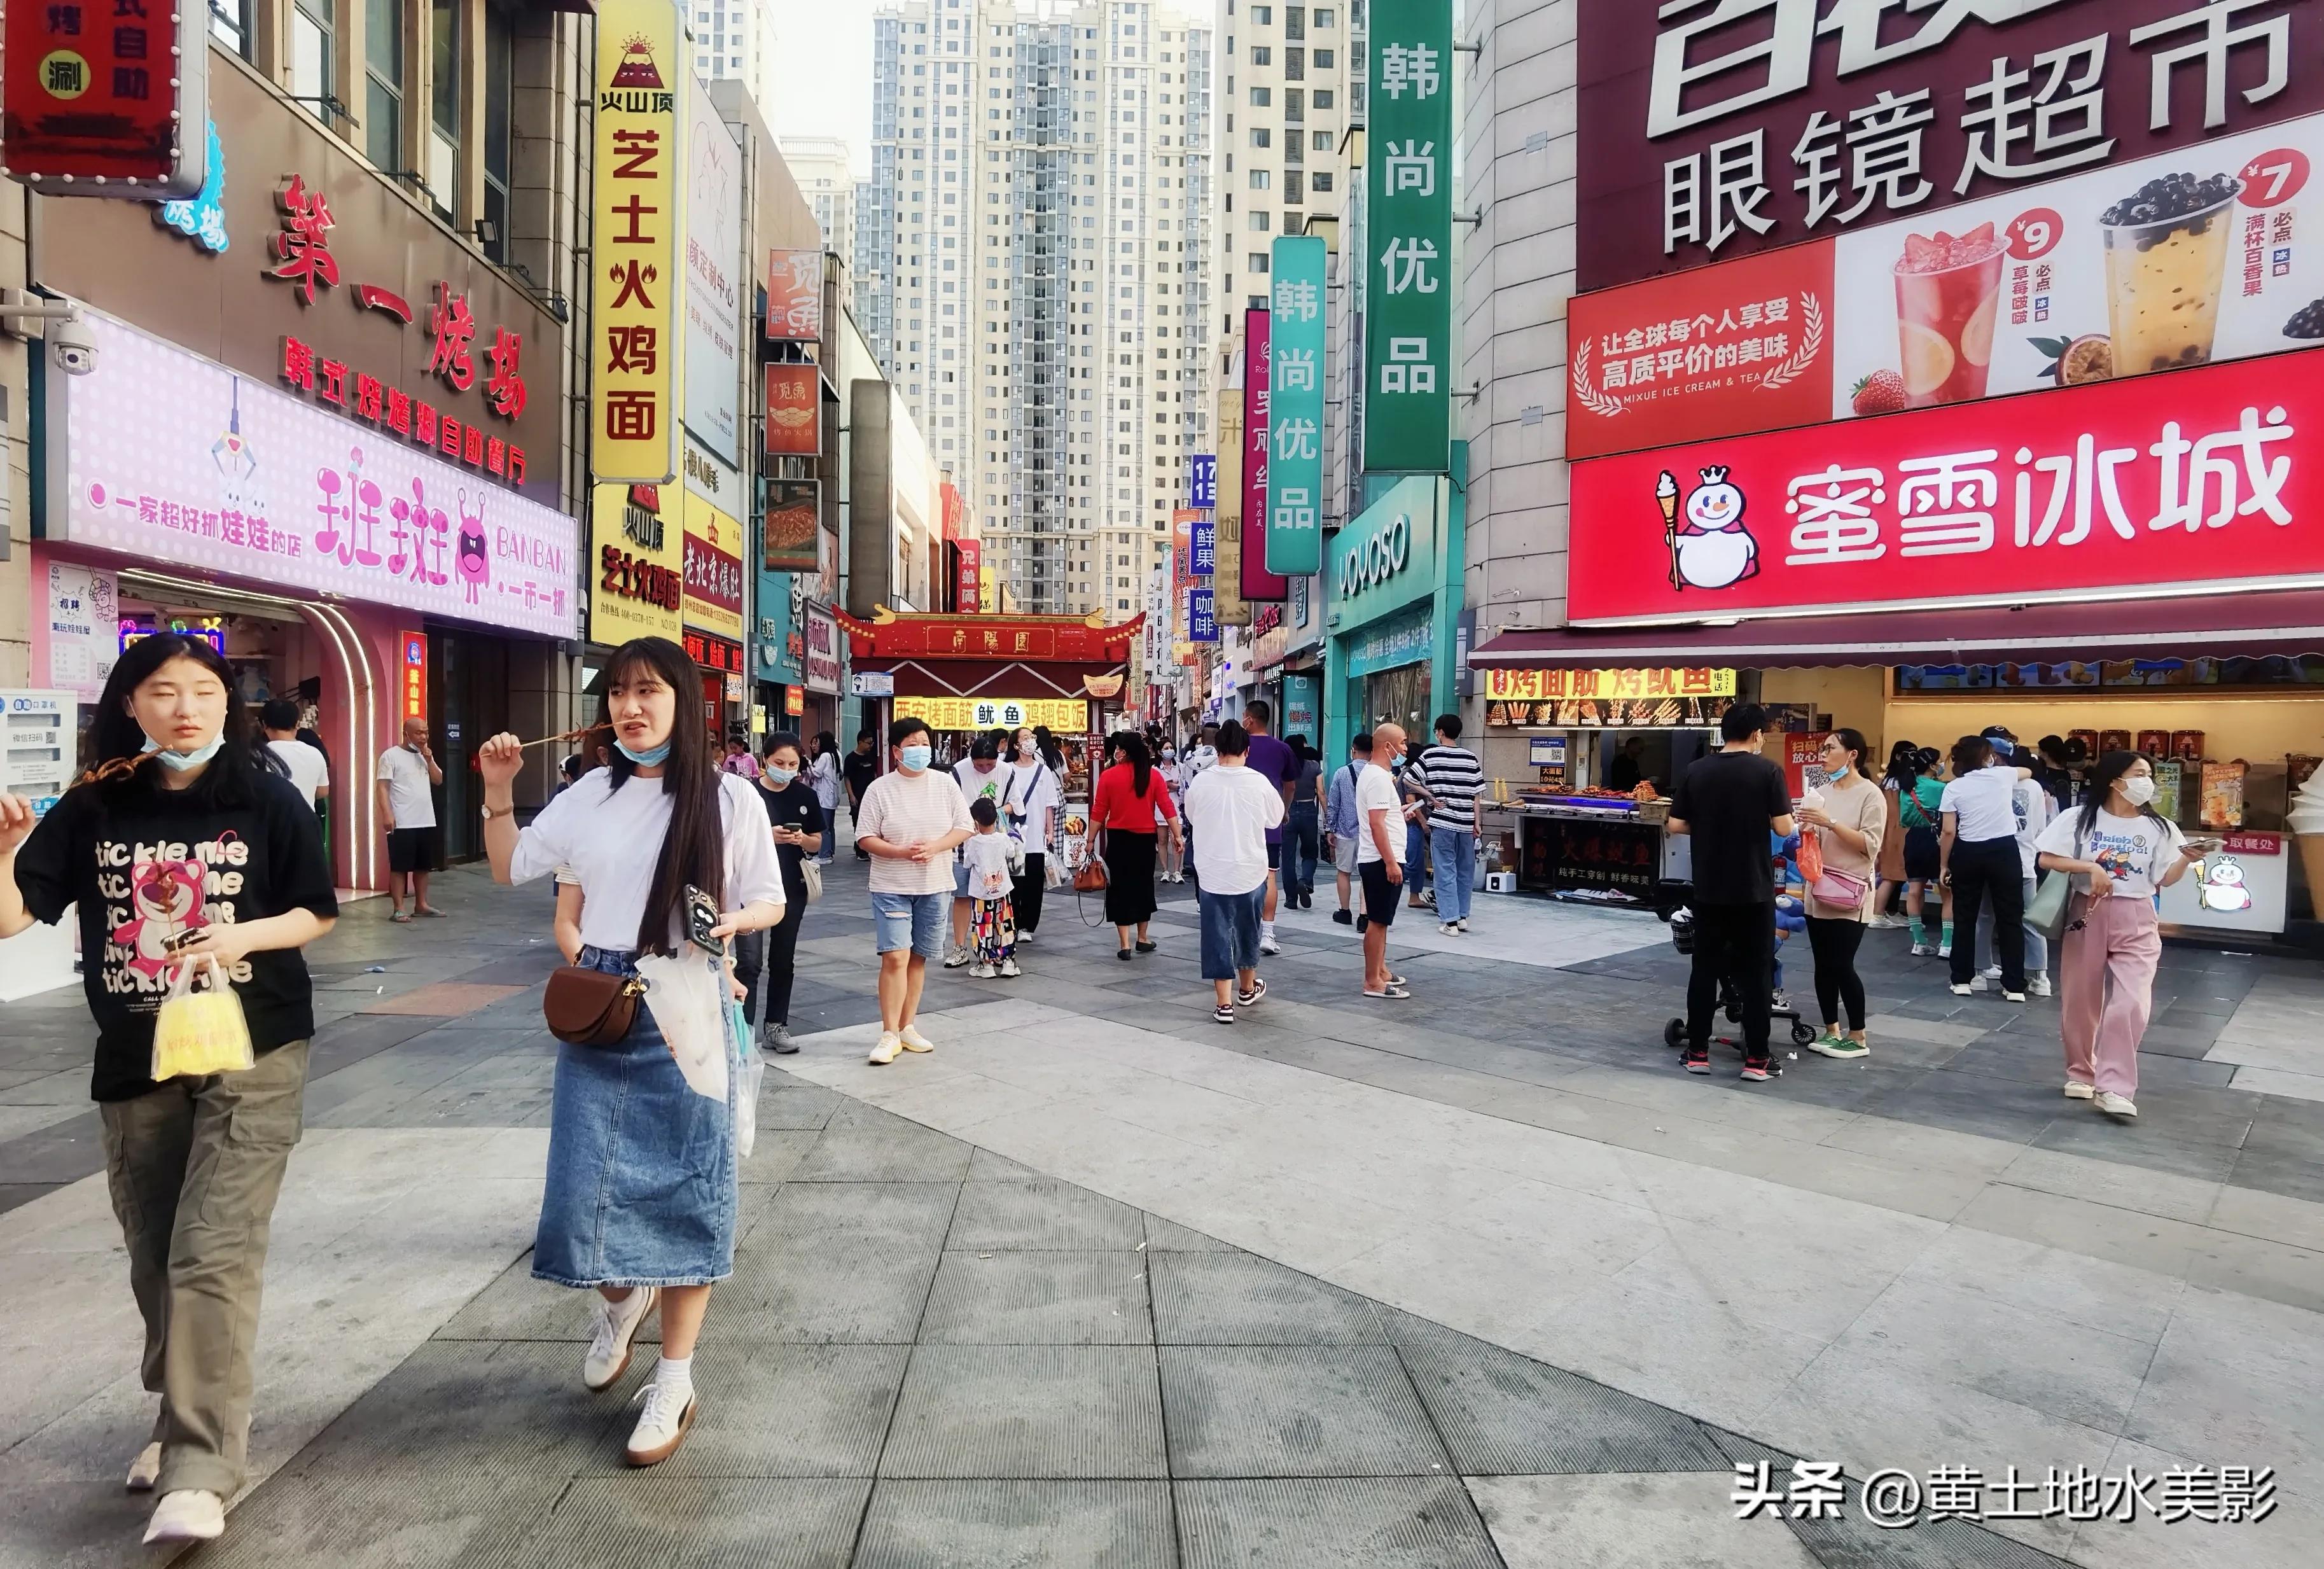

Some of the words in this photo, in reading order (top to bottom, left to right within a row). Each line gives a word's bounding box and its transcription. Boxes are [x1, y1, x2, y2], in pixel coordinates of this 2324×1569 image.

[49, 60, 81, 91] 涮
[601, 92, 673, 113] 火山顶
[1664, 0, 2291, 253] 眼镜超市
[1380, 42, 1439, 394] 韩尚优品
[2273, 212, 2292, 243] 必点
[2036, 265, 2051, 291] 必点
[2243, 214, 2265, 296] 满杯百香果
[607, 129, 659, 440] 芝士火鸡面
[1601, 296, 1789, 357] 让全球每个人享受
[1601, 333, 1789, 391] 高质平价的美味
[286, 337, 526, 485] 韩式烧烤涮自助餐厅
[1274, 279, 1318, 530] 韩尚优品
[1624, 389, 1657, 405] MIXUE
[1662, 387, 1680, 398] ICE
[1685, 379, 1721, 393] CREAM
[1725, 377, 1734, 387] &
[1739, 372, 1761, 384] TEA
[1784, 405, 2295, 567] 蜜雪冰城
[116, 496, 302, 559] 一家超好抓娃娃的店
[496, 526, 566, 576] BANBAN
[622, 507, 664, 553] 火山顶
[1196, 527, 1214, 568] 鲜果
[684, 541, 740, 604] 老北京爆肚
[1339, 514, 1407, 600] YOYOSO
[60, 598, 81, 612] 招聘
[509, 580, 566, 618] 一币一抓
[1195, 597, 1214, 636] 咖啡
[13, 733, 43, 743] 微信扫码
[978, 704, 1020, 725] 鱿鱼
[2229, 837, 2274, 850] 取餐处
